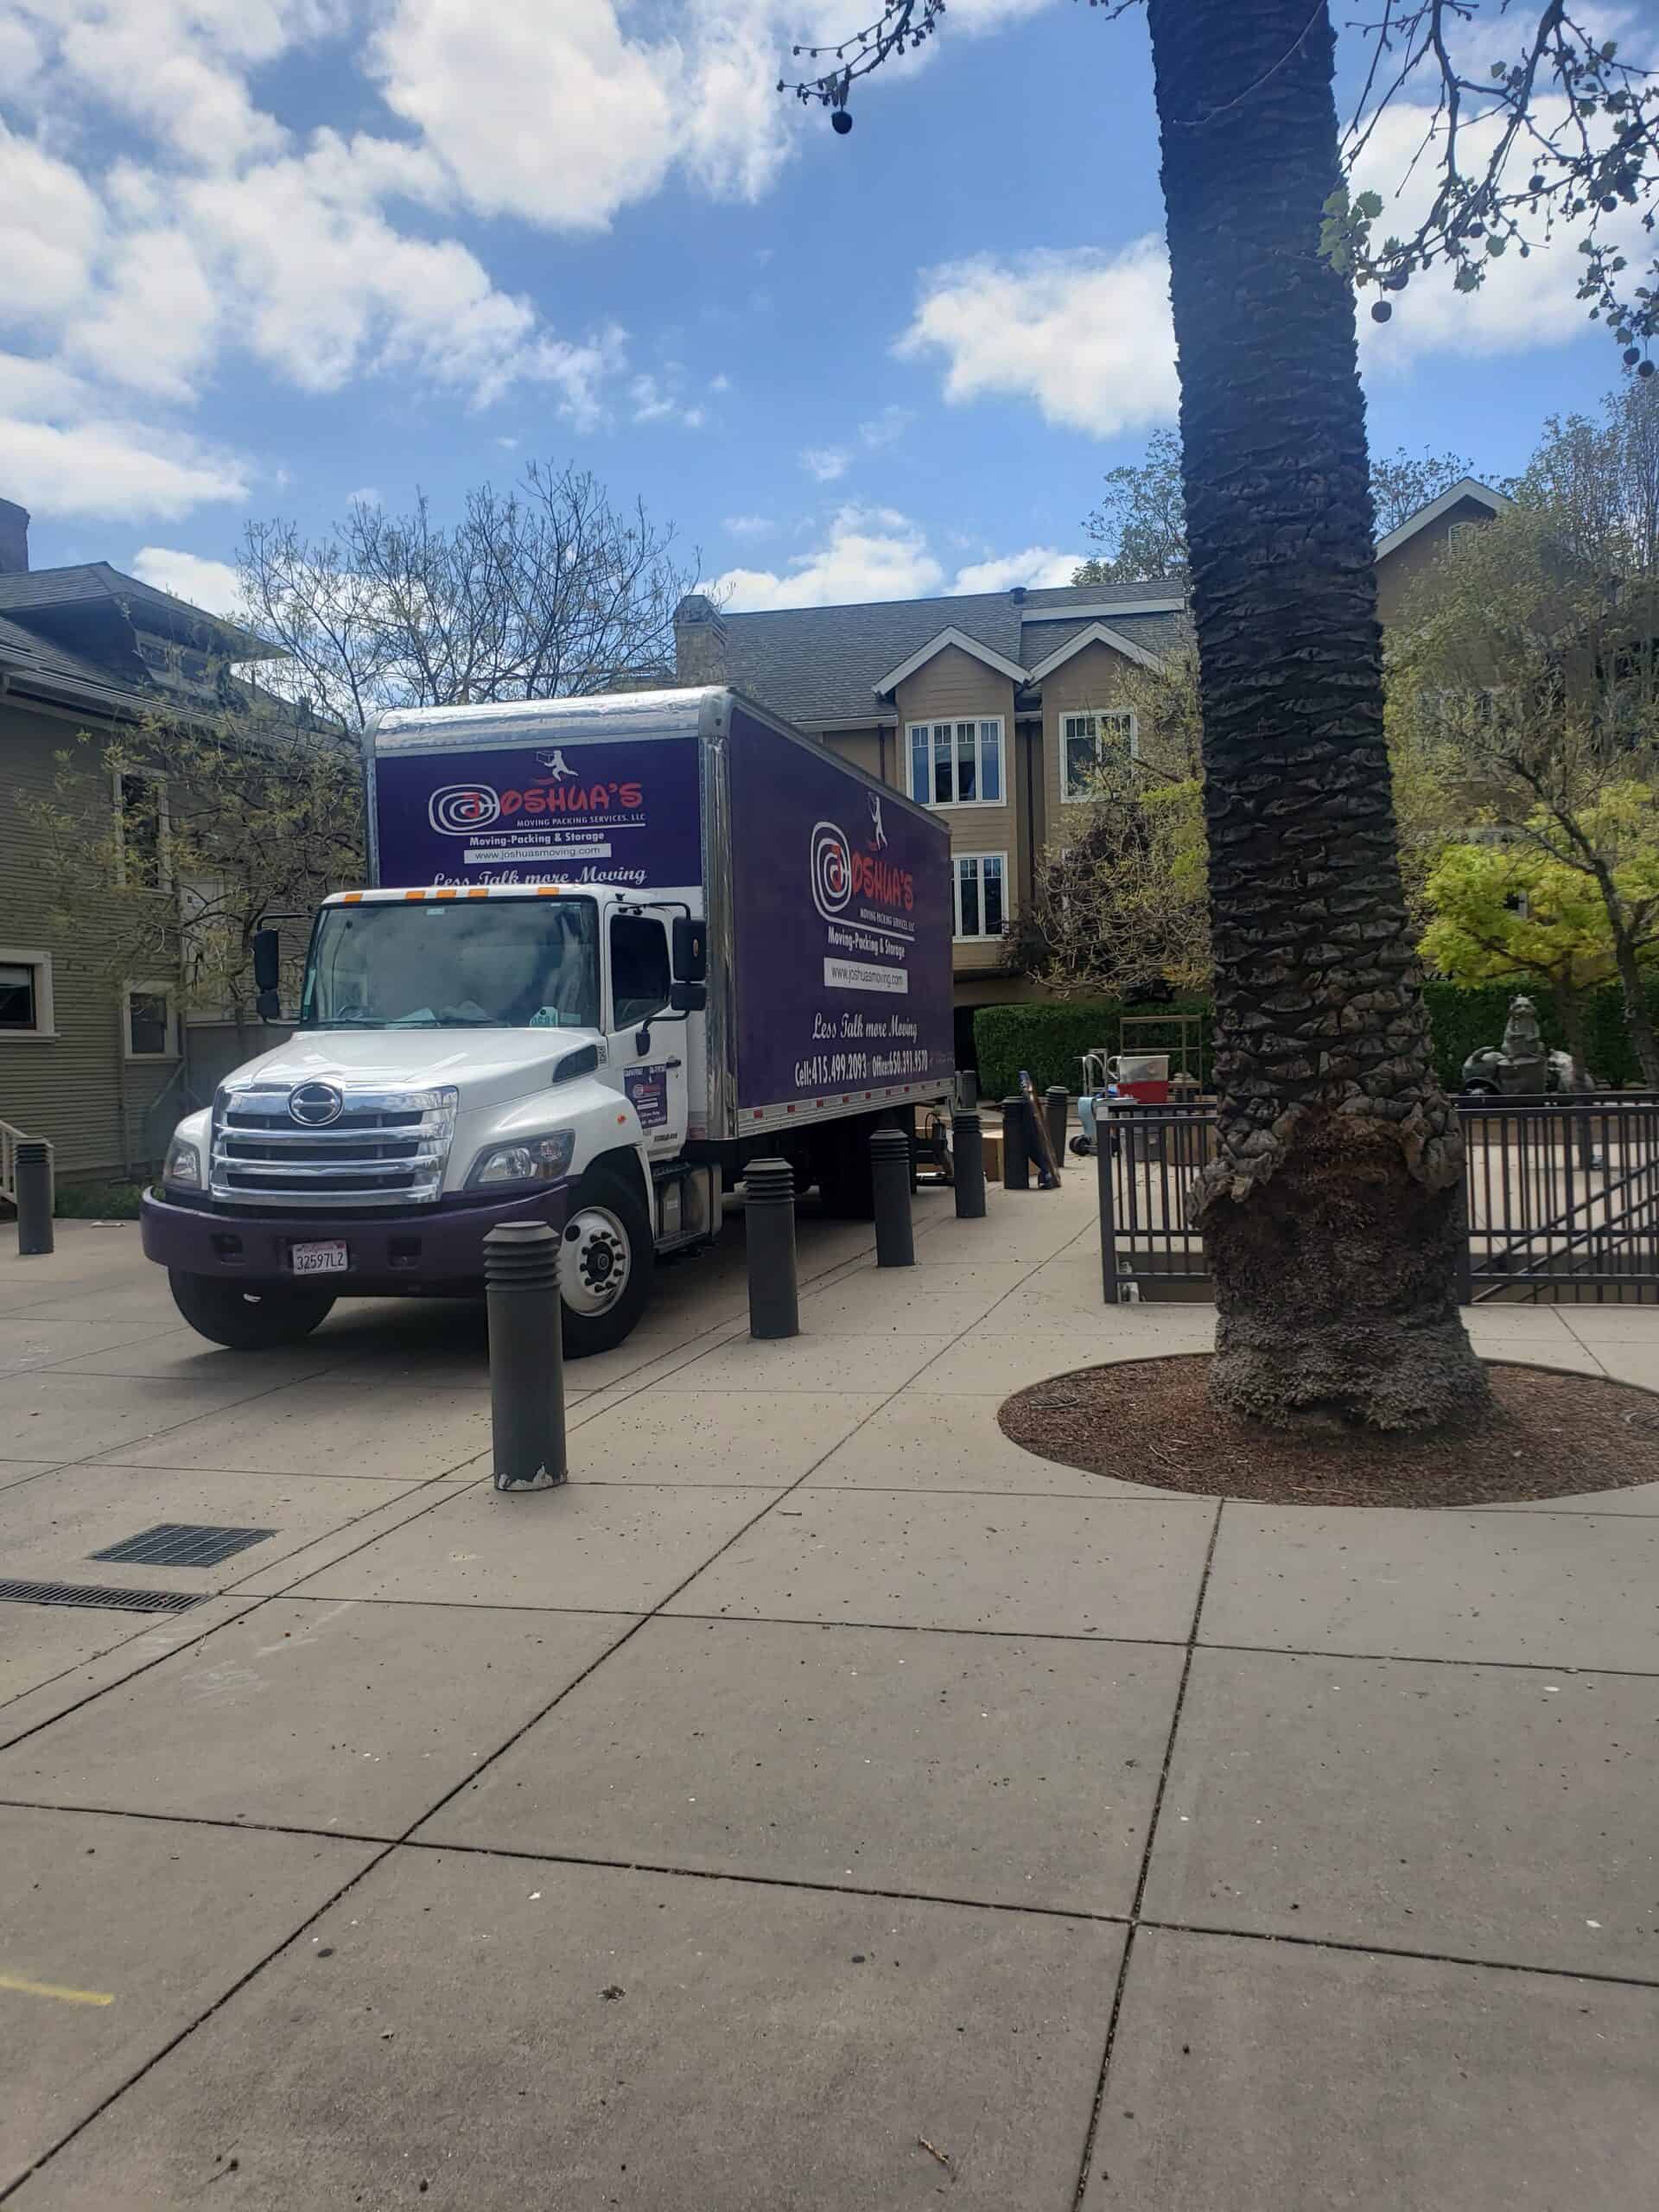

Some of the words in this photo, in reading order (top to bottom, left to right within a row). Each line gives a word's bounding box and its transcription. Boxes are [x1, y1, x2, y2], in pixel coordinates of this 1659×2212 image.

[462, 783, 643, 818] JOSHUA'S
[469, 834, 551, 846] Moving-Packing
[554, 833, 562, 842] &
[565, 831, 605, 842] Storage
[475, 847, 601, 860] www.joshuasmoving.com
[434, 873, 470, 886] Less
[477, 870, 519, 885] Talk
[525, 873, 570, 884] more
[575, 866, 647, 885] Moving
[828, 926, 879, 957] Moving-Packing
[885, 939, 906, 960] Storage
[831, 965, 903, 987] www.joshuasmoving.com
[812, 1013, 836, 1039] Less
[841, 1013, 864, 1038] Talk
[865, 1022, 887, 1037] more
[888, 1014, 918, 1044] Moving
[296, 1251, 344, 1269] 32597L2
